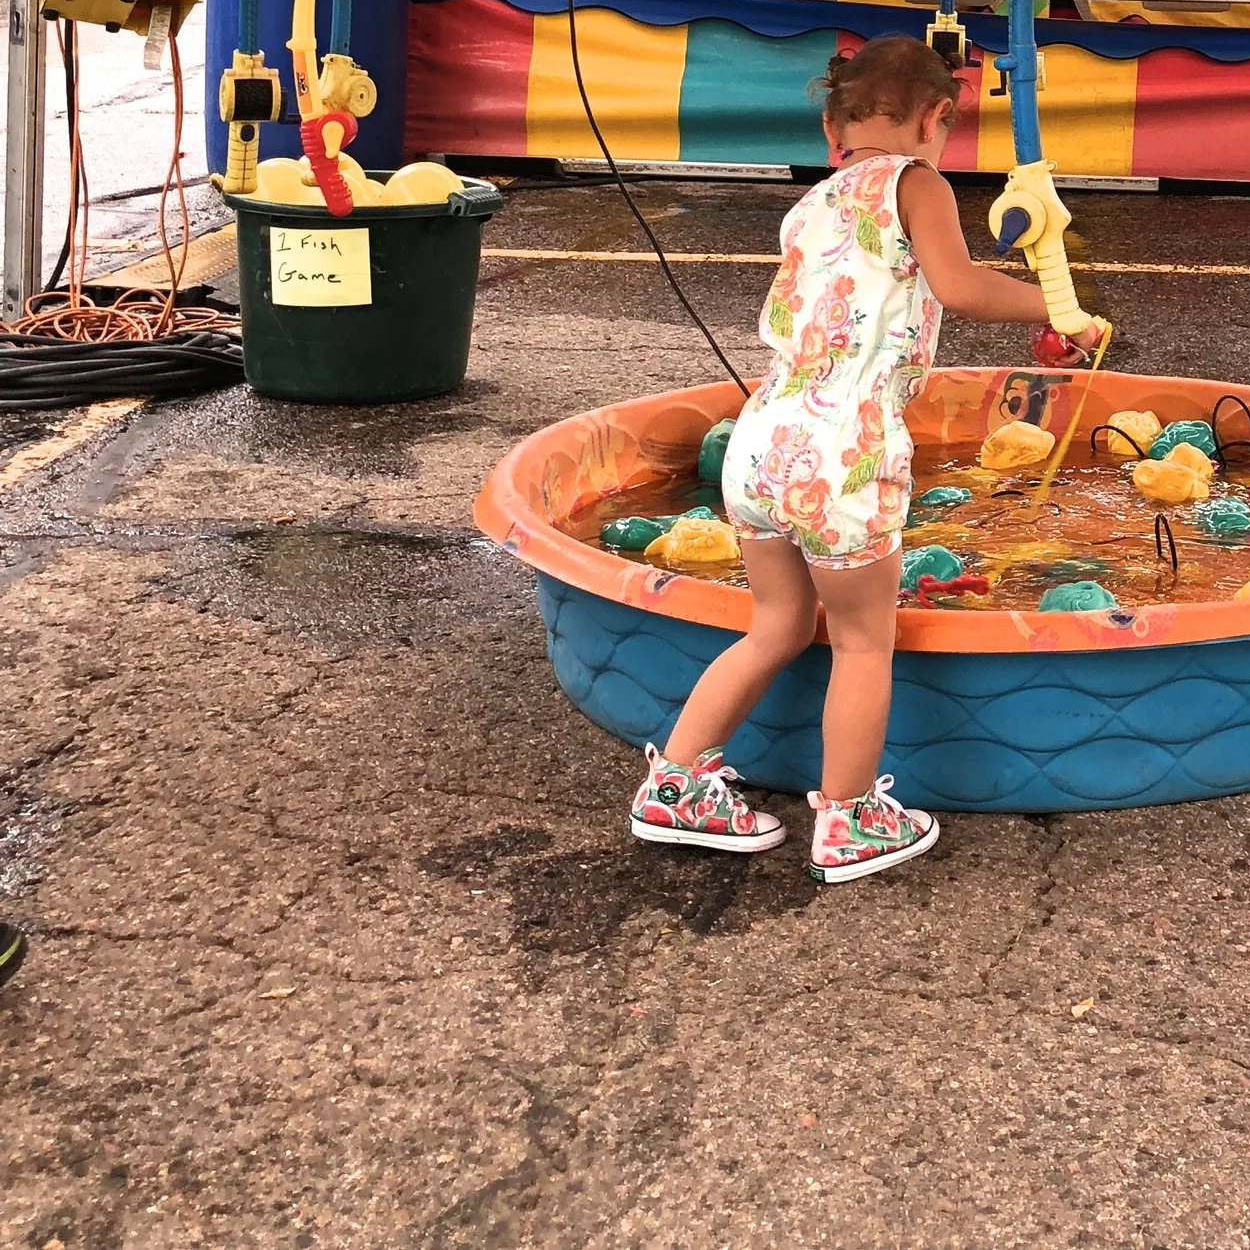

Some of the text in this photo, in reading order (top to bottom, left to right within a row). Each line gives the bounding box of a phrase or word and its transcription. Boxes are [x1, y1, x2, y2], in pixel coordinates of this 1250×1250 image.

[276, 232, 342, 256] 1 Fish
[278, 261, 342, 283] Game
